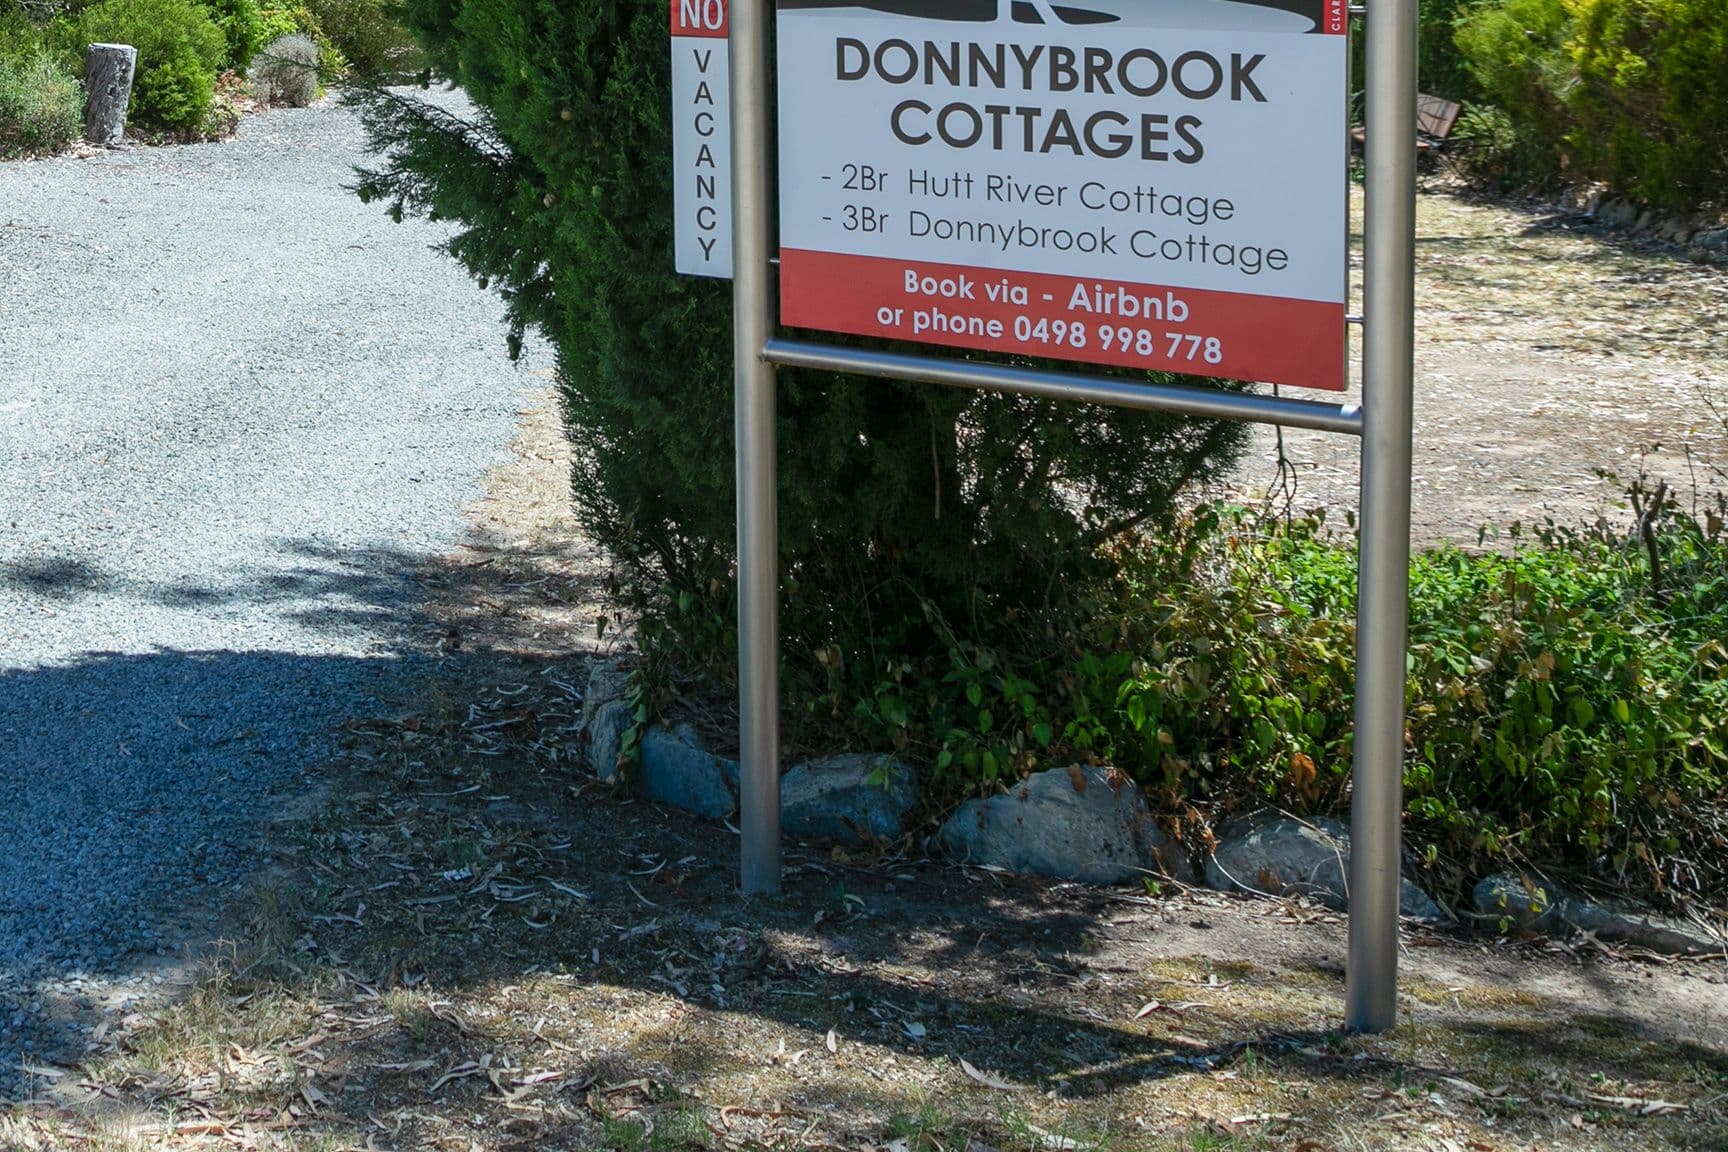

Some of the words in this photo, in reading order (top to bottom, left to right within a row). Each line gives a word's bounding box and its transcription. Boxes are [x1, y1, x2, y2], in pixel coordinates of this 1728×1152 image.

[836, 37, 1269, 103] DONNYBROOK
[693, 49, 717, 261] VACANCY
[890, 99, 1205, 164] COTTAGES
[841, 164, 889, 193] 2Br
[908, 169, 975, 200] Hutt
[986, 175, 1068, 206] River
[1079, 181, 1235, 226] Cottage
[842, 205, 889, 233] 3Br
[909, 210, 1118, 256] Donnybrook
[1130, 229, 1289, 275] Cottage
[904, 269, 976, 300] Book
[984, 279, 1029, 306] via
[1067, 283, 1190, 323] Airbnb
[876, 306, 904, 326] or
[913, 308, 1004, 338] phone
[1013, 315, 1087, 349] 0498
[1098, 325, 1154, 356] 998
[1165, 333, 1223, 365] 778
